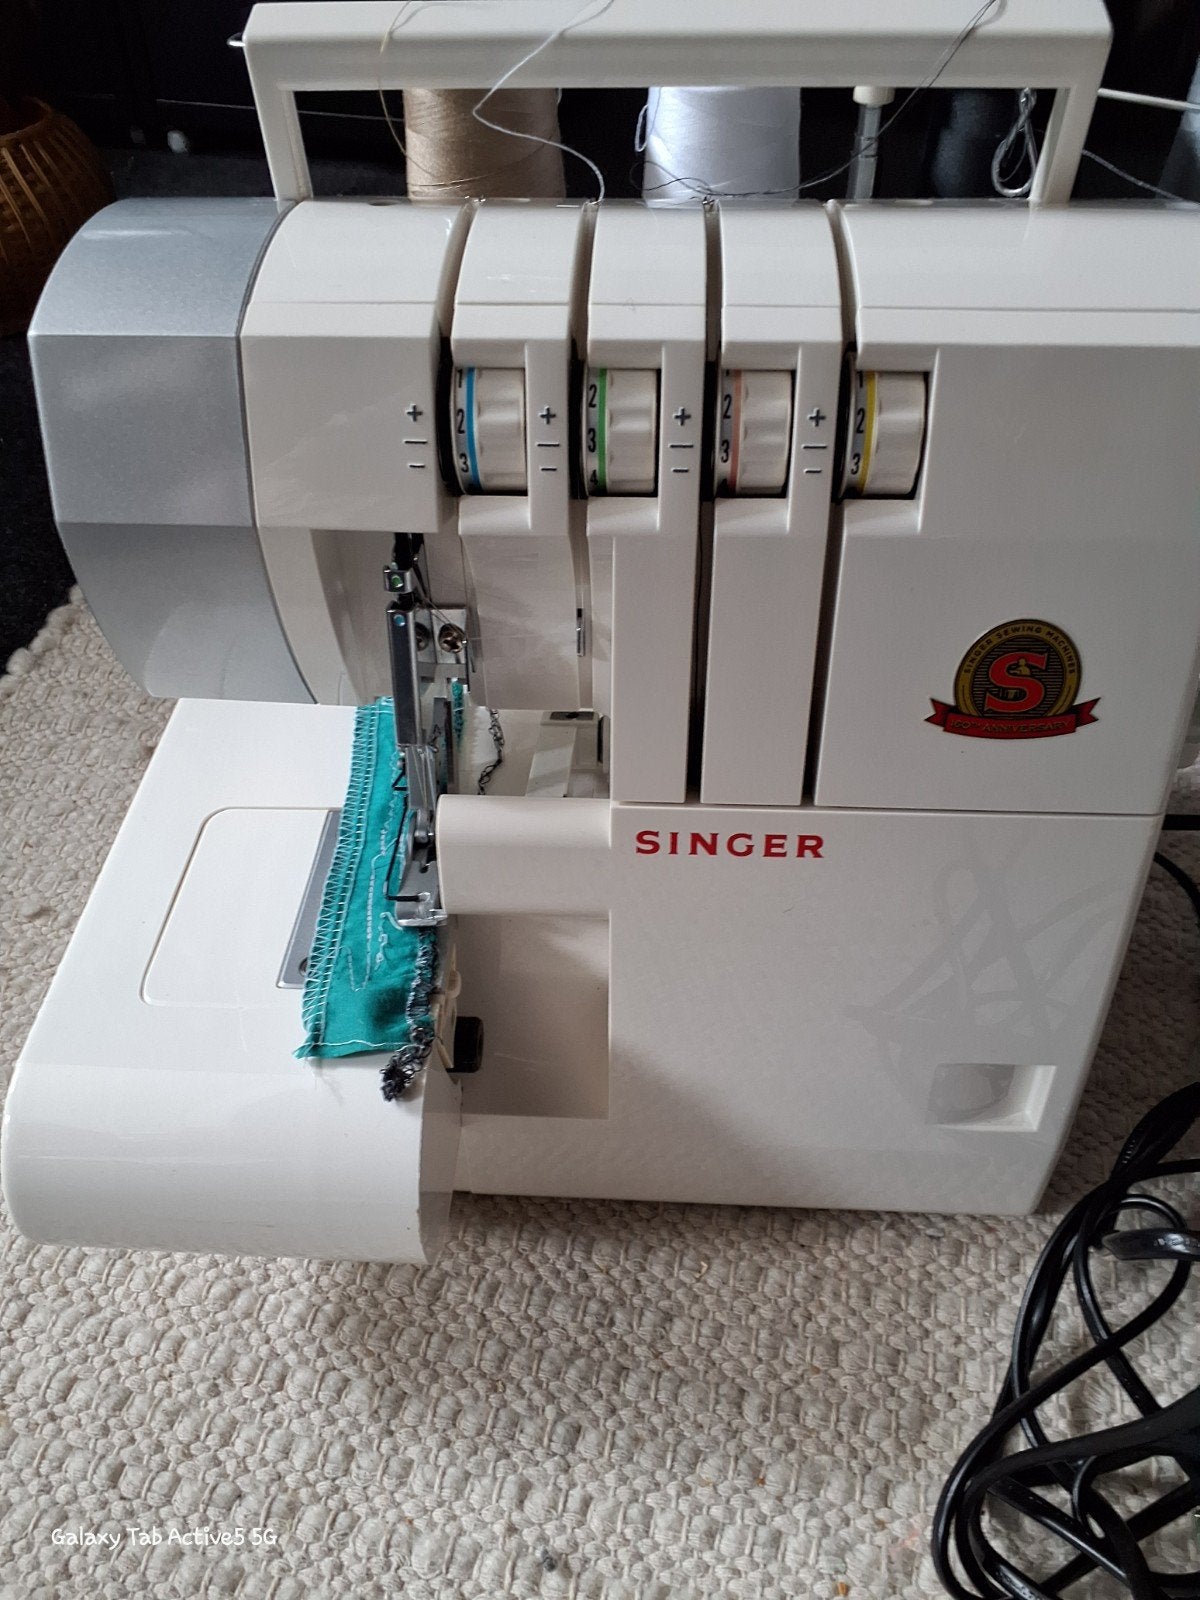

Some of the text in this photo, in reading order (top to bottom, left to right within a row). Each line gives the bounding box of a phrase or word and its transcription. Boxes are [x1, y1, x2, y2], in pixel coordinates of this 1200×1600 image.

[456, 369, 463, 388] 1
[589, 384, 597, 408] 2
[723, 394, 732, 420] 2
[457, 408, 465, 434] 2
[856, 408, 865, 434] 2
[588, 428, 597, 453] 3
[721, 440, 730, 463] 3
[459, 453, 470, 473] 3
[851, 453, 861, 475] 3
[590, 469, 598, 484] 4
[963, 625, 1076, 675] SINGER SEWING MACHINES
[984, 651, 1048, 714] S
[982, 720, 1070, 733] ANNIVERSARY
[635, 830, 824, 858] SINGER
